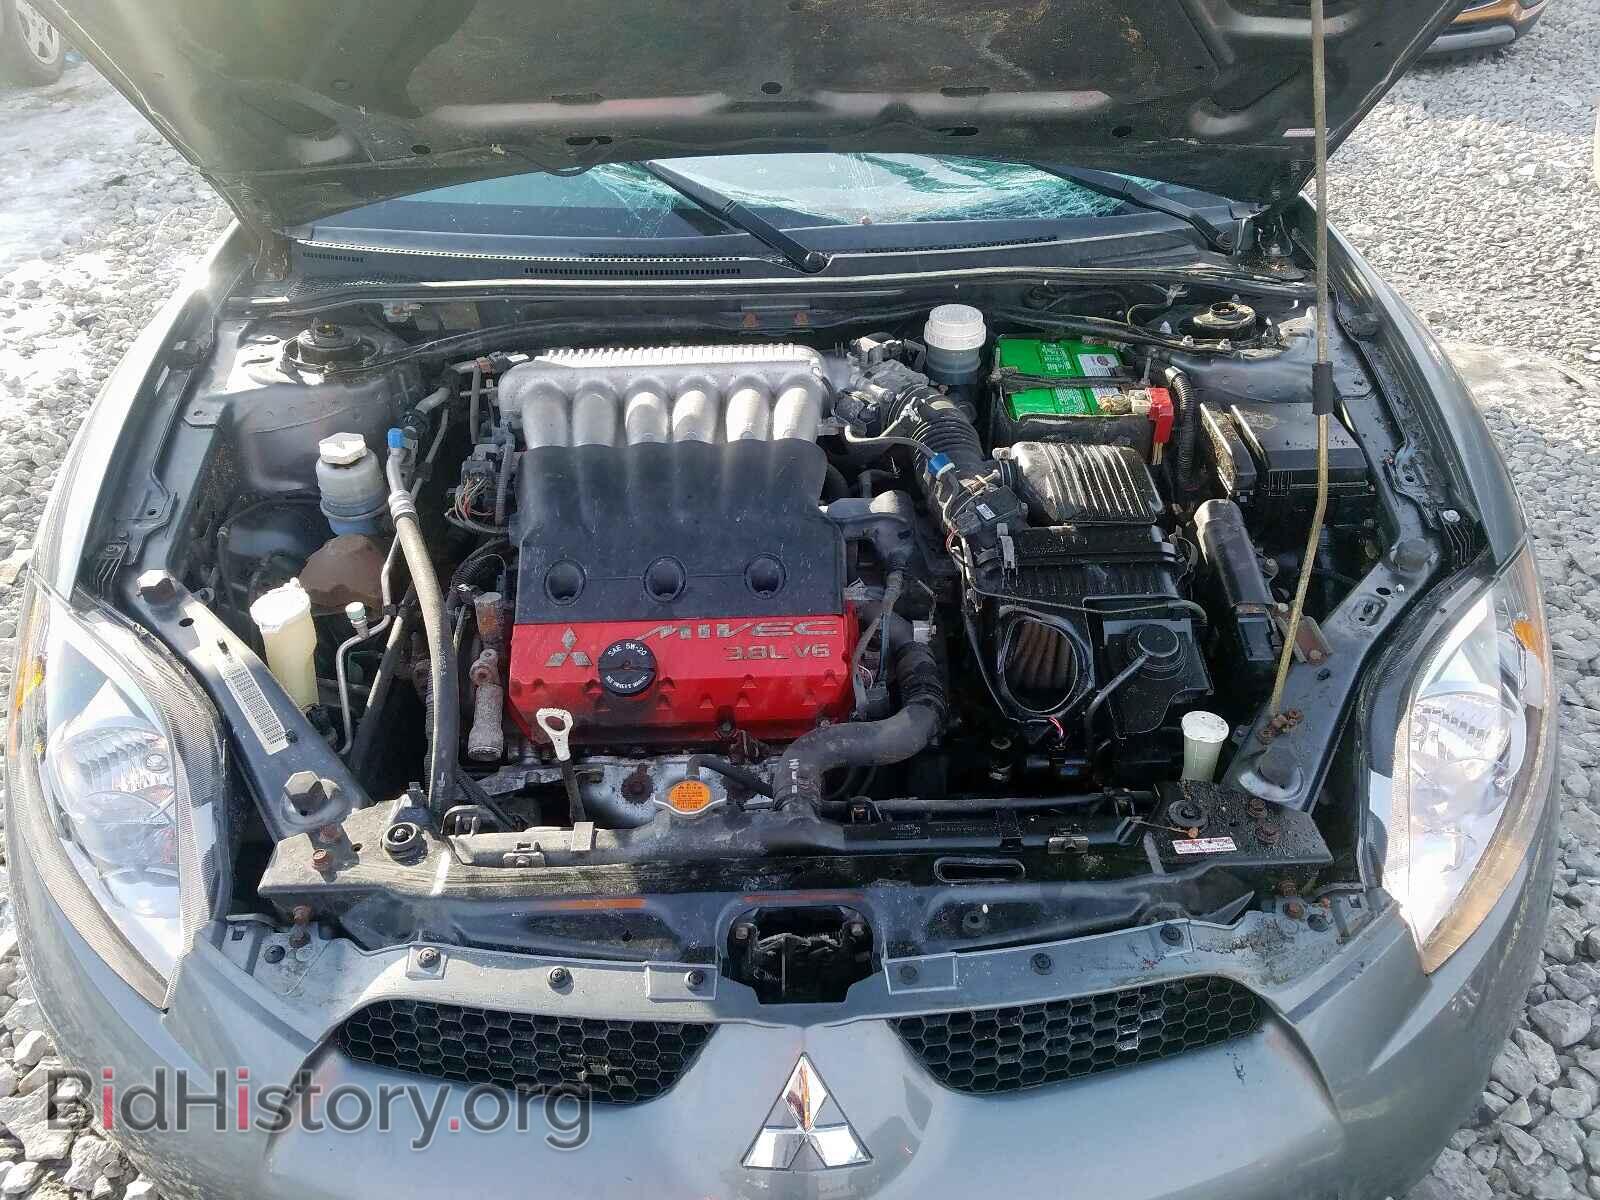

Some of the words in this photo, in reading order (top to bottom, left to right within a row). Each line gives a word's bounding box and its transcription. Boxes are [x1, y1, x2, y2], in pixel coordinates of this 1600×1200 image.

[637, 620, 837, 641] MIVEC
[607, 644, 622, 657] SAE
[625, 642, 648, 656] 5W-20
[725, 644, 789, 660] 3.8L
[795, 643, 830, 658] V6
